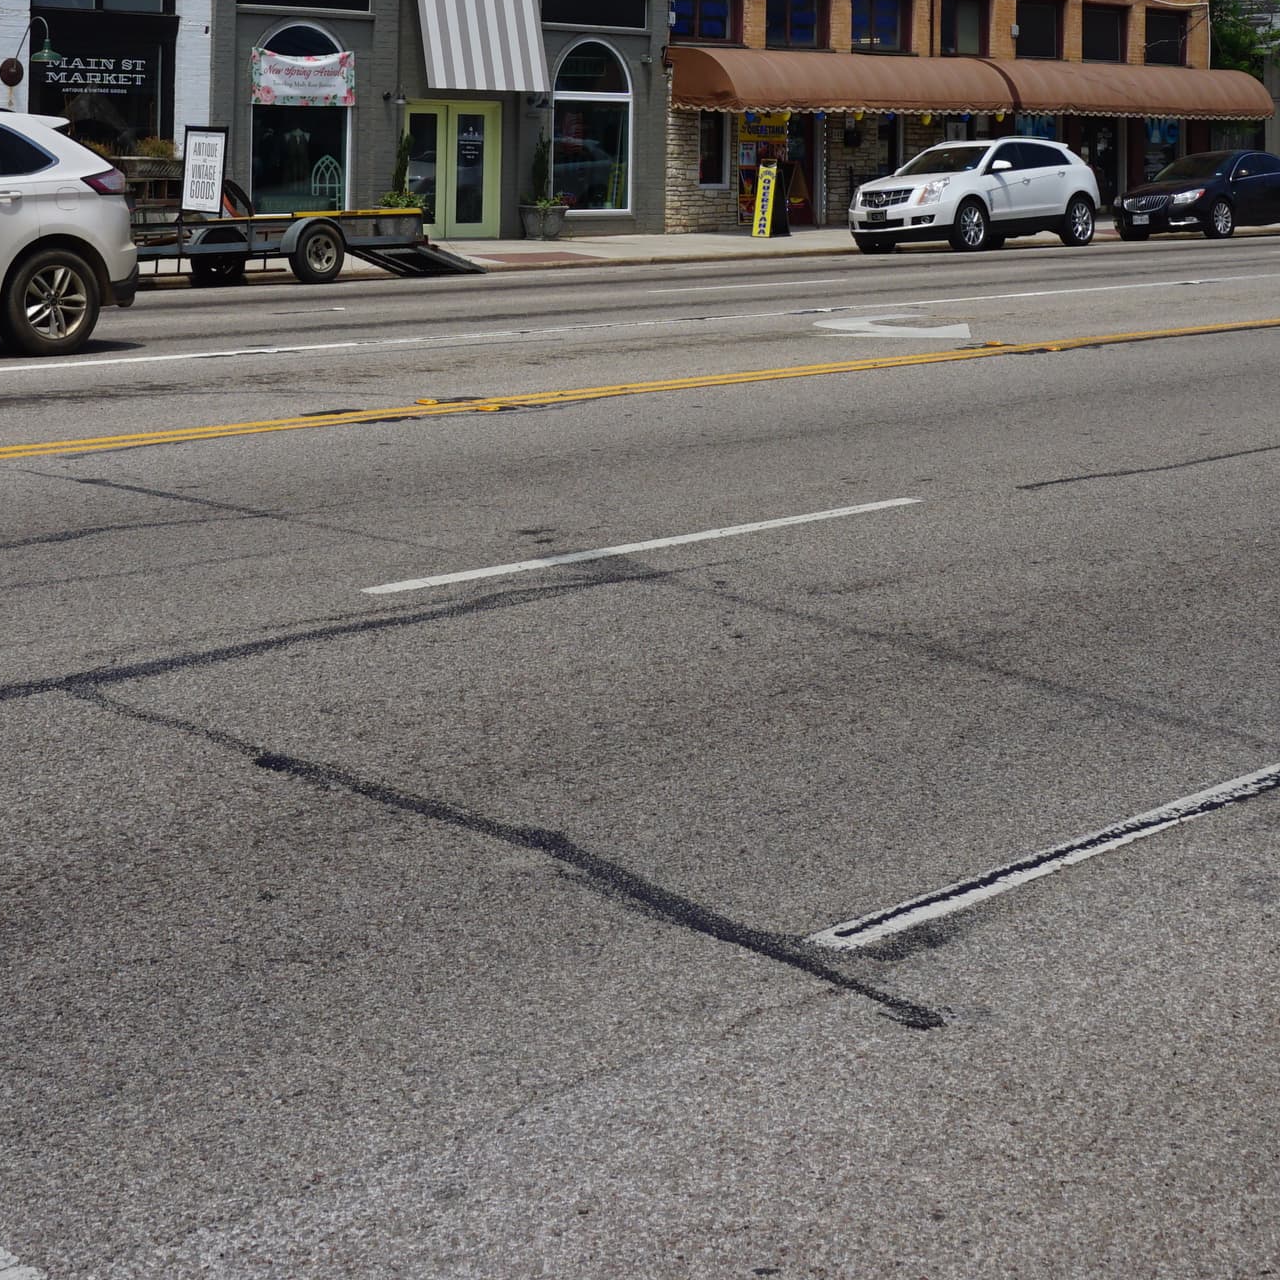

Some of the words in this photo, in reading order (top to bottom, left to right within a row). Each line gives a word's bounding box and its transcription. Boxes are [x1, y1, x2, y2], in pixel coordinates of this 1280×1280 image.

[45, 57, 116, 70] MAIN
[45, 72, 145, 85] MARKET
[284, 65, 312, 80] Spring
[193, 142, 218, 157] ANTIQUE
[191, 164, 216, 180] VINTAGE
[189, 180, 216, 200] GOODS
